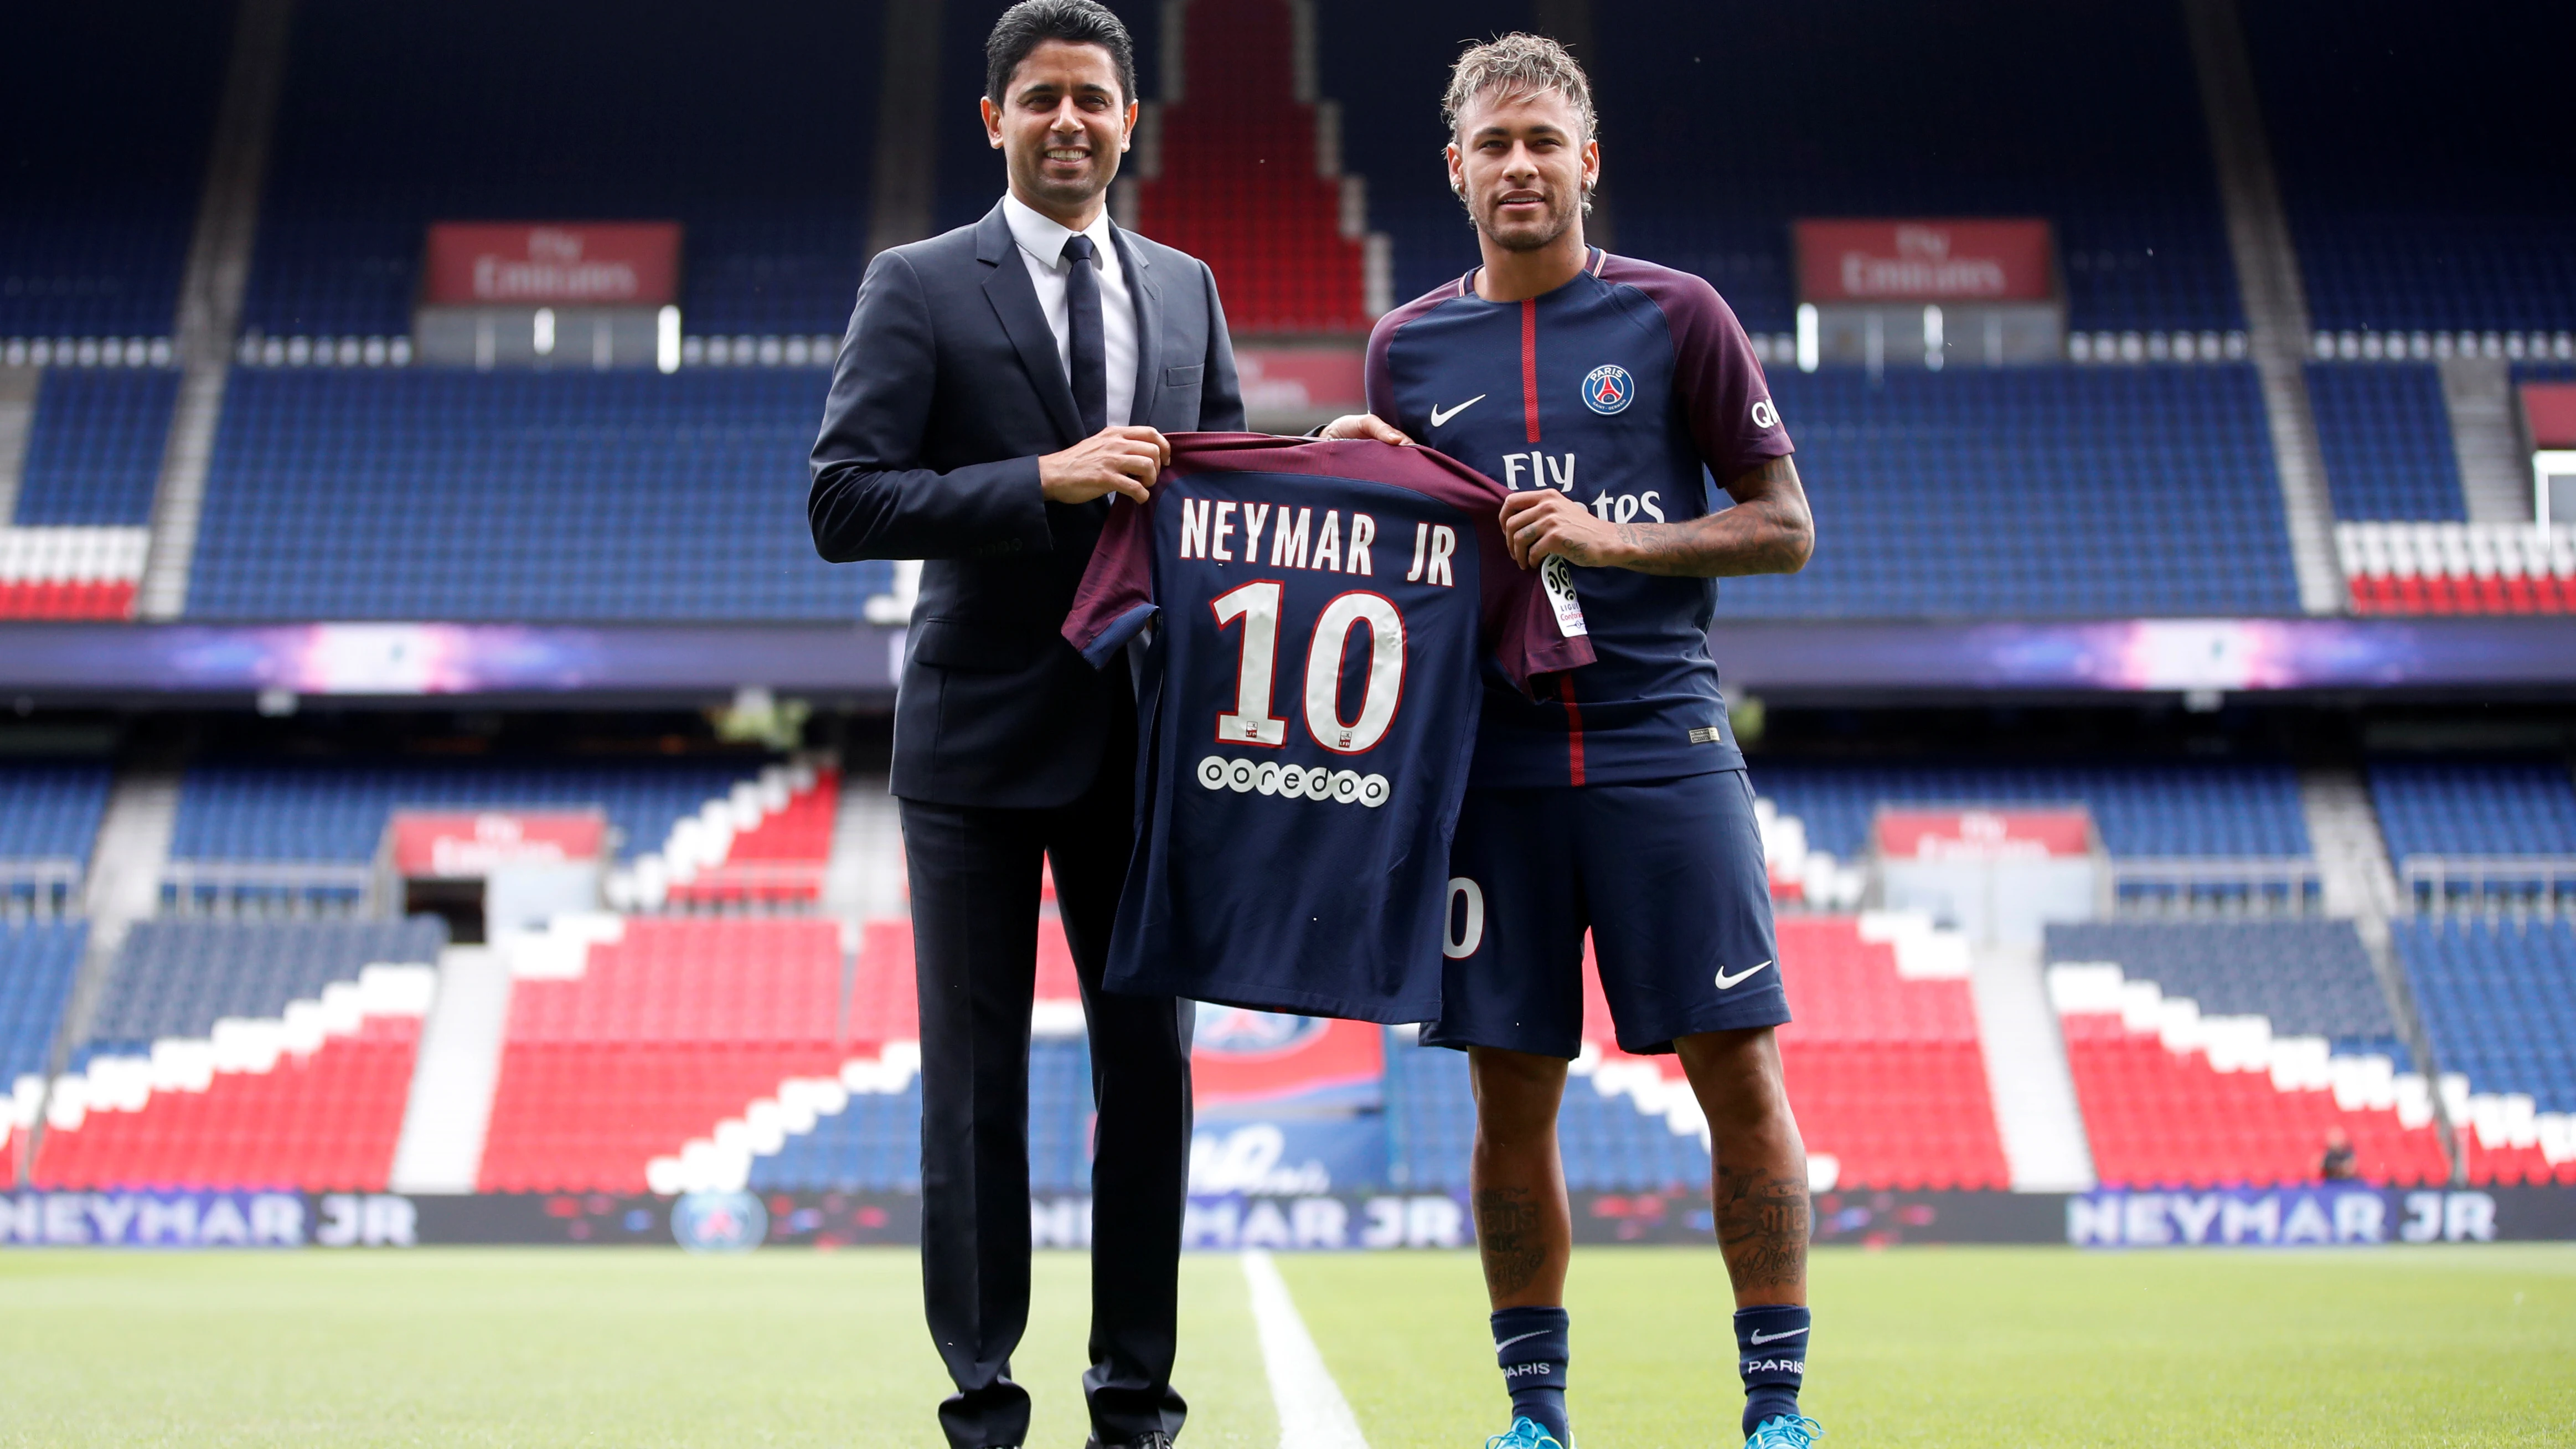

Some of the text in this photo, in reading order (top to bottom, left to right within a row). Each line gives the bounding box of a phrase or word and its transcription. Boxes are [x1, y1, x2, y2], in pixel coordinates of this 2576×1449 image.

[1590, 367, 1624, 381] PARIS
[1502, 451, 1575, 492] Fly
[1179, 498, 1457, 587] NEYMAR JR
[1560, 602, 1579, 612] LIGUE
[1209, 579, 1407, 756] 10
[1204, 763, 1382, 800] ooredoo
[0, 1193, 418, 1246] NEYMAR JR
[1361, 1196, 1463, 1247] JR
[2066, 1192, 2497, 1245] NEYMAR JR
[1748, 1359, 1804, 1374] PARIS
